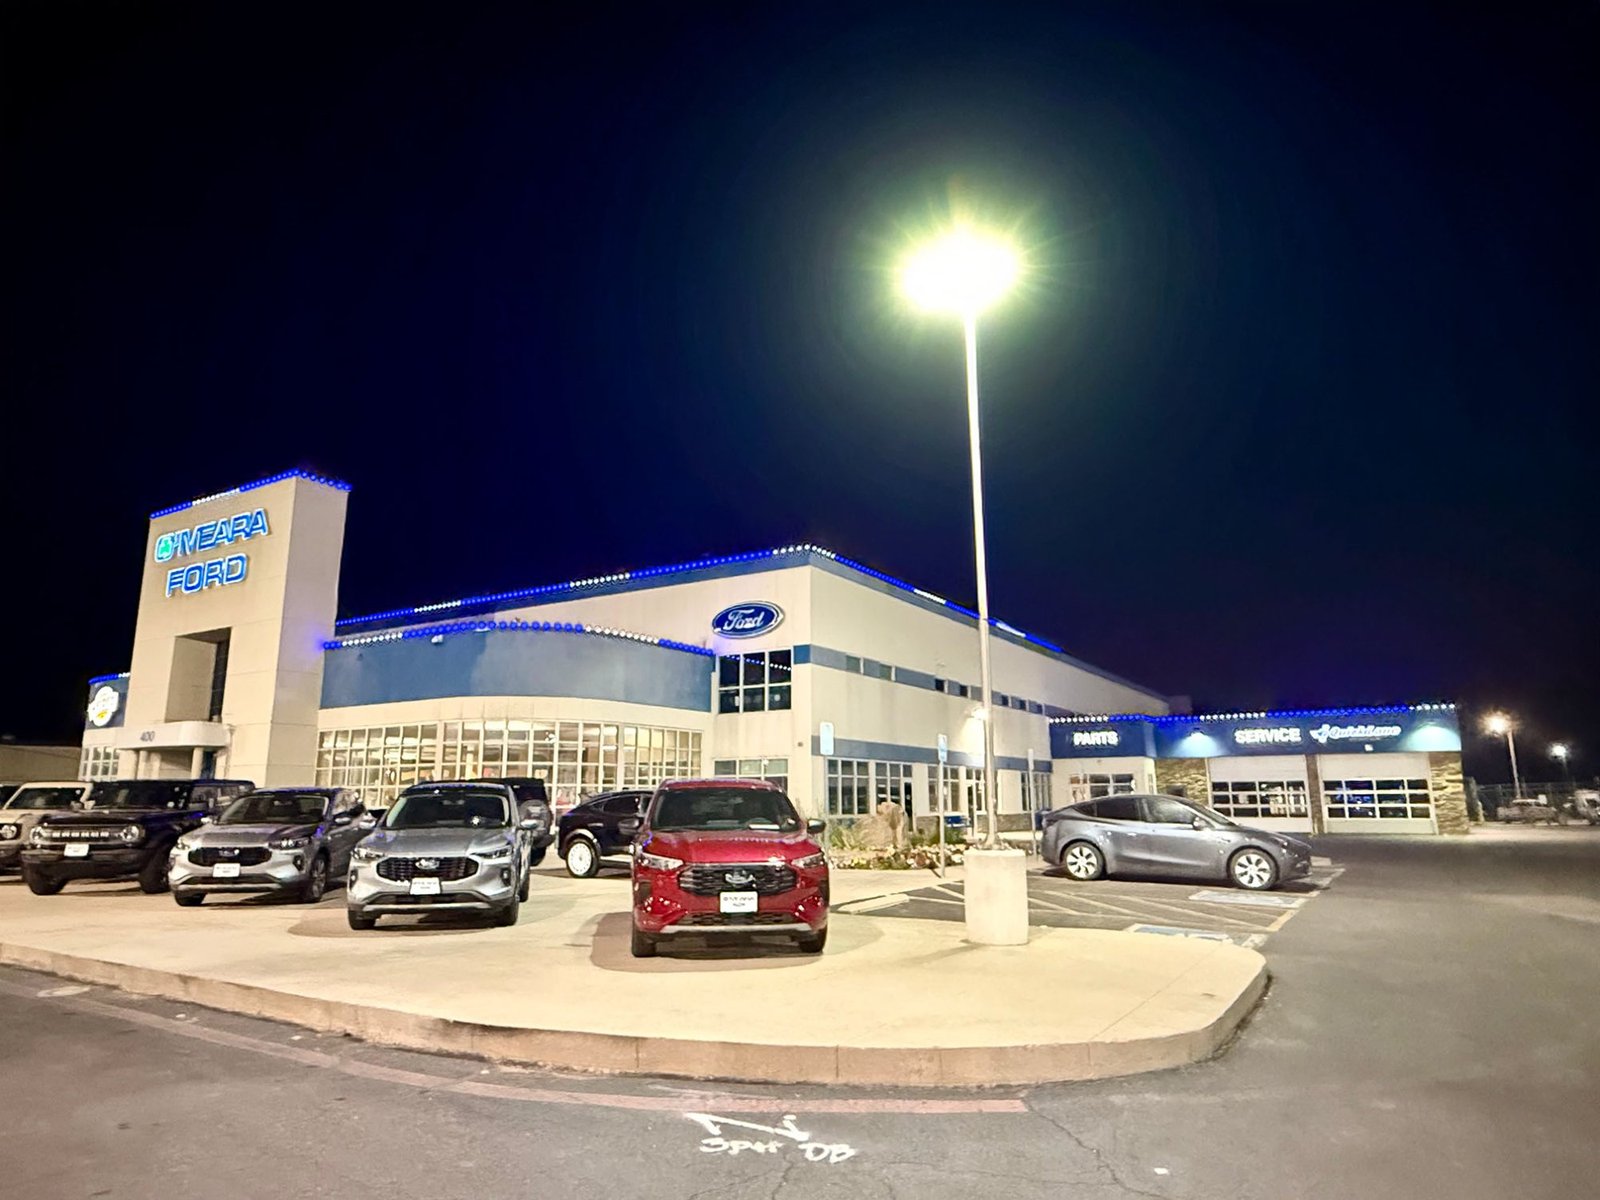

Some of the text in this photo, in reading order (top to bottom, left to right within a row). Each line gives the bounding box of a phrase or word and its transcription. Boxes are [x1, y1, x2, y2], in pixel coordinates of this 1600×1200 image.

[165, 553, 247, 598] FORD
[723, 608, 765, 630] Ford
[1072, 730, 1119, 746] PARTS
[1234, 727, 1302, 744] SERVICE
